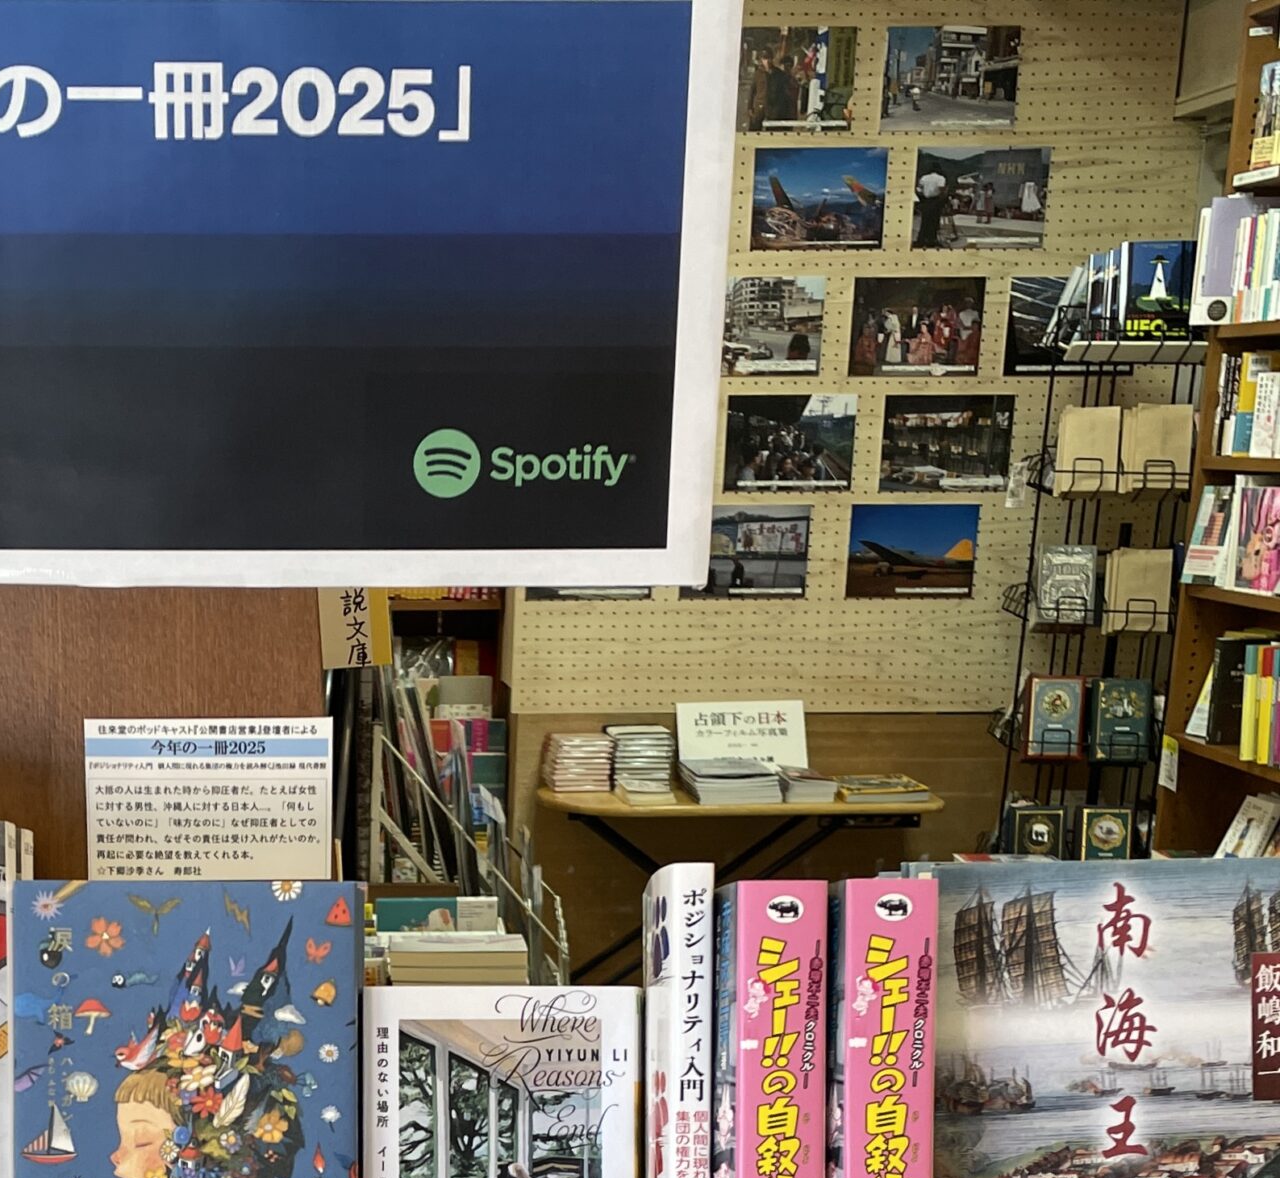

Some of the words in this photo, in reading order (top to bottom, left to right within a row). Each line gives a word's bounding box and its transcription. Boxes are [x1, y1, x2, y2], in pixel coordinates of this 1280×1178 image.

[489, 443, 629, 487] Spotify
[695, 711, 787, 727] 占領下の日本
[151, 740, 266, 756] 今年の一冊2025
[495, 990, 600, 1044] Where
[680, 887, 707, 1104] ポジショナリティ入門
[546, 1048, 600, 1062] YIYUN
[613, 1048, 628, 1061] LI
[538, 1104, 619, 1151] End
